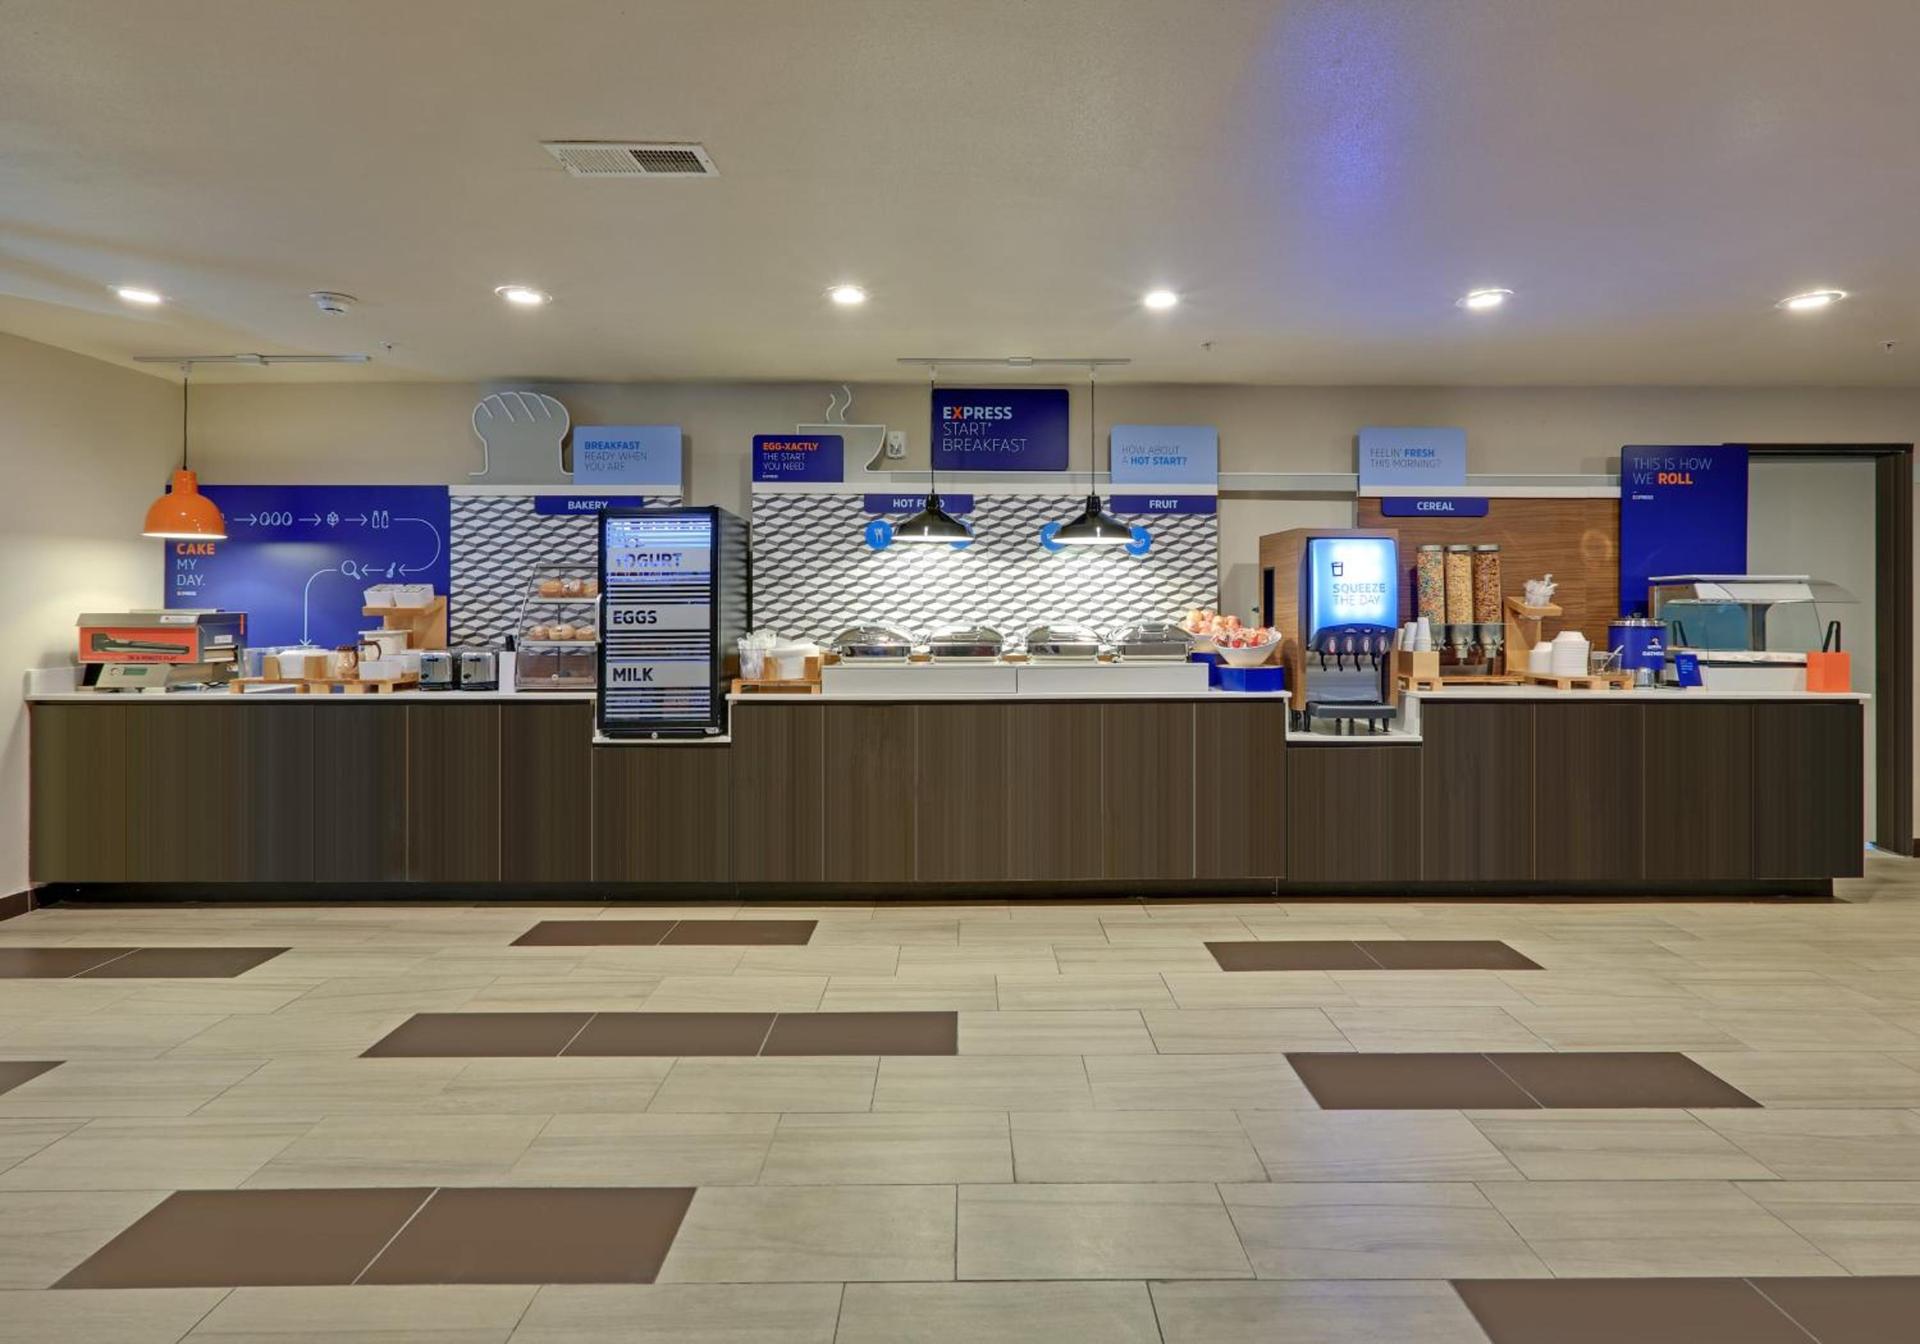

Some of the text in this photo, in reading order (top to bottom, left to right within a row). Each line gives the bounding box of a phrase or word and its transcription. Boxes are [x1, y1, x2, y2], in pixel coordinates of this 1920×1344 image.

[943, 406, 1013, 420] EXPRESS
[584, 441, 640, 450] BREAKFAST
[762, 442, 819, 451] EGG-XACTLY
[943, 438, 1028, 452] BREAKFAST
[1122, 445, 1179, 455] HOW ABOUT
[584, 452, 648, 461] READY WHEN
[763, 452, 806, 460] THE START
[1404, 448, 1435, 458] FRESH
[1130, 456, 1151, 465] HOT
[1152, 456, 1188, 465] START?
[1370, 459, 1391, 468] THIS
[1632, 457, 1713, 471] THIS IS HOW
[584, 462, 625, 472] YOU ARE
[763, 462, 806, 470] YOU NEED
[1632, 472, 1694, 485] WE ROLL
[567, 501, 609, 510] BAKERY
[892, 499, 945, 508] HOT FD
[1149, 500, 1179, 509] FRUIT
[1416, 501, 1455, 511] CEREAL
[176, 543, 216, 555] CAKE
[176, 559, 197, 570] MY
[176, 574, 206, 586] DAY.
[1332, 583, 1387, 594] SQUEEZE
[1332, 595, 1381, 606] THE DAY
[612, 610, 658, 625] EGGS
[612, 667, 653, 682] MILK
